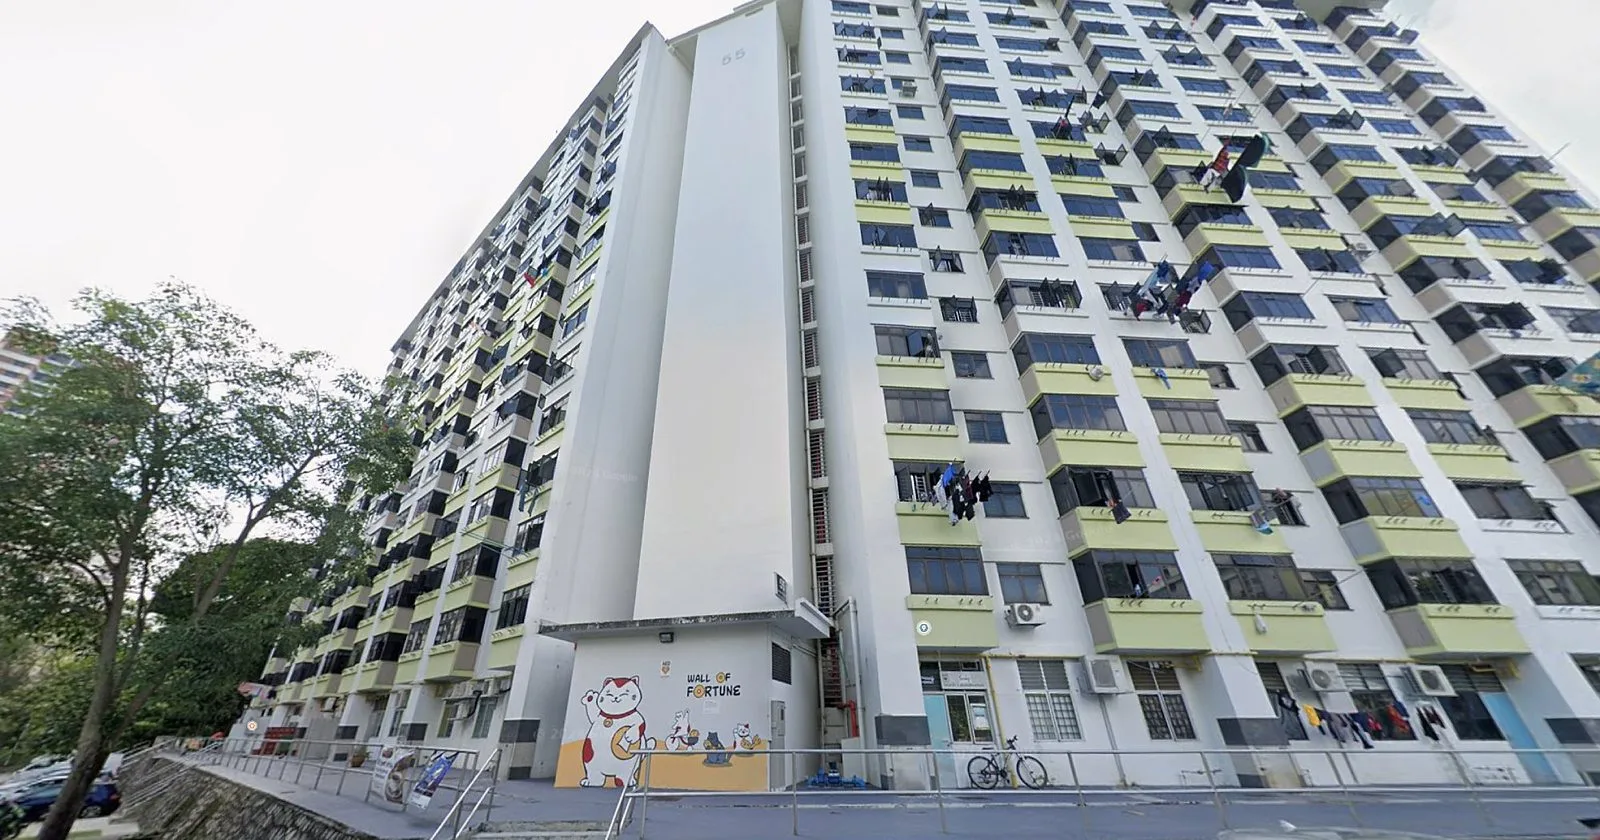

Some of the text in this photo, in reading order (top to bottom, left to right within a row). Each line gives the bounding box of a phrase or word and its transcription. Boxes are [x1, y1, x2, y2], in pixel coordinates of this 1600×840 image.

[687, 671, 731, 684] WALL OF
[686, 684, 741, 699] FORTUNE
